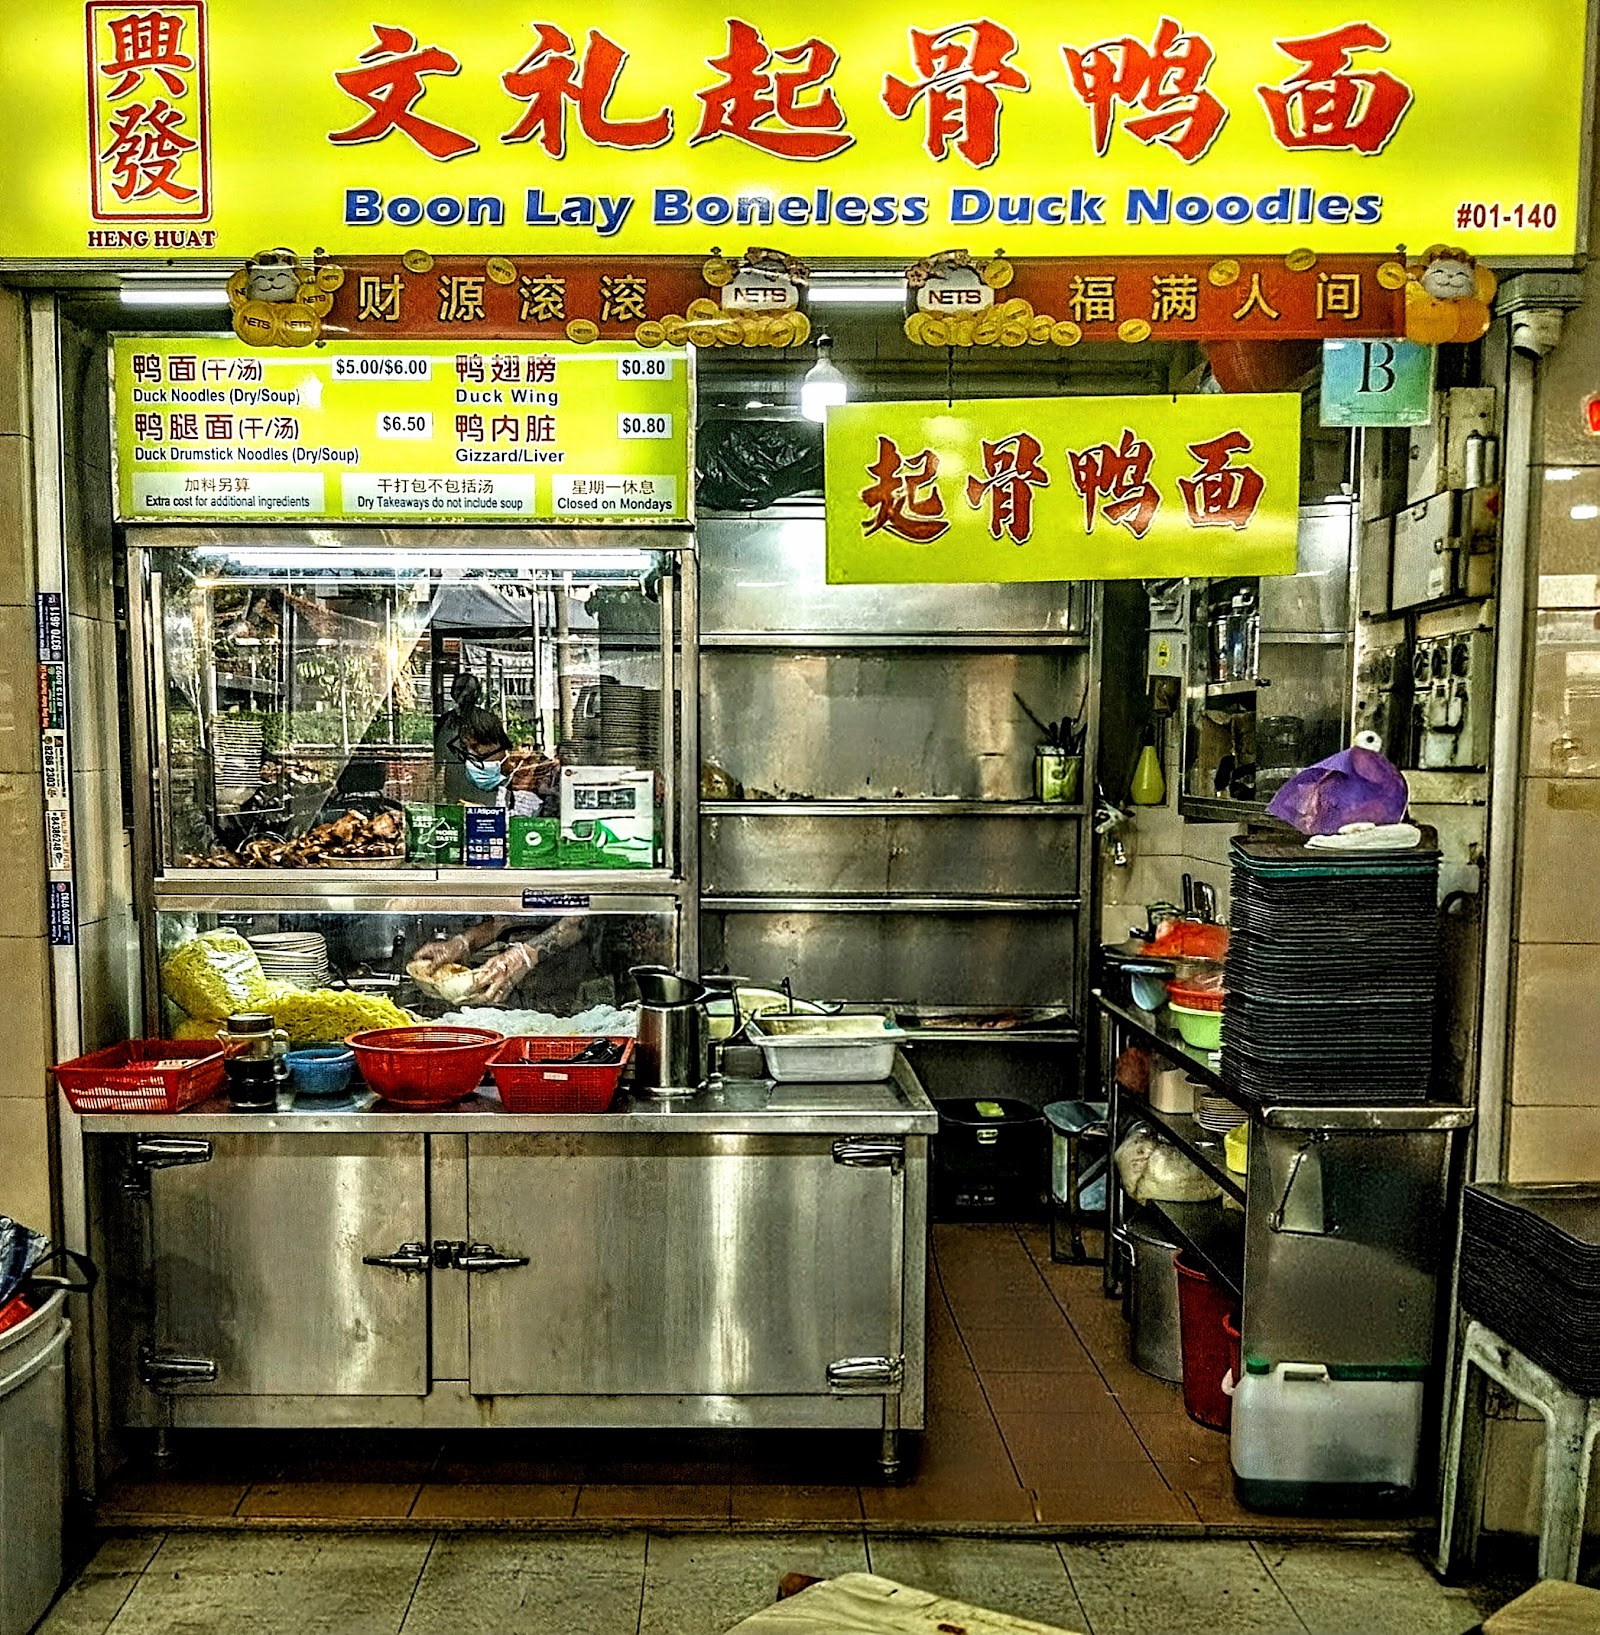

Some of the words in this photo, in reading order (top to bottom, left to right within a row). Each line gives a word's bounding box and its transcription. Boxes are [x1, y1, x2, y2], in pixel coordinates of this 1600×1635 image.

[329, 16, 1414, 168] 文礼起骨鸭面
[100, 11, 198, 200] 興發
[345, 188, 503, 224] Boon
[525, 188, 632, 234] Lay
[652, 187, 928, 224] Boneless
[950, 187, 1105, 224] Duck
[1126, 186, 1382, 224] Noodles
[1457, 203, 1557, 229] #01-140
[88, 231, 148, 248] HENG
[154, 231, 216, 248] HUAT
[357, 274, 648, 322] 财源滚滚
[733, 287, 788, 303] NETS
[928, 288, 982, 305] NETS
[1069, 273, 1361, 322] 福满人间
[243, 315, 271, 330] NETS
[336, 359, 428, 376] $5.00/$6.00
[455, 353, 556, 383] 鸭翅膀
[621, 358, 666, 376] $0.80
[1357, 341, 1396, 393] B
[133, 389, 167, 402] Duck
[171, 389, 225, 402] Noodles
[229, 388, 300, 406] (Dry/Soup)
[456, 389, 503, 403] Duck
[511, 389, 559, 406] Wing
[383, 416, 426, 432] $6.50
[455, 413, 556, 443] 鸭内脏
[622, 416, 666, 434] $0.80
[135, 448, 167, 461] Duck
[170, 447, 234, 461] Drumstick
[237, 448, 289, 461] Noodles
[292, 447, 359, 464] (Dry/Soup)
[456, 449, 565, 462] Gizzard/Liver
[184, 477, 251, 493] 加料另算
[377, 478, 494, 494] 干打包不包括汤
[571, 479, 656, 495] 星期一休息
[861, 426, 1268, 545] 起骨鸭面
[146, 495, 171, 507] Extra
[173, 496, 192, 507] cost
[195, 495, 208, 507] for
[210, 495, 256, 507] additional
[258, 495, 310, 510] ingredients
[358, 496, 376, 510] Dry
[378, 496, 430, 510] Takeaways
[432, 496, 444, 508] do
[447, 497, 462, 508] not
[464, 496, 498, 508] include
[501, 499, 523, 511] soup
[557, 497, 599, 510] Closed
[602, 499, 616, 510] on
[620, 497, 673, 512] Mondays
[49, 607, 61, 627] 4611
[50, 629, 62, 650] 9370
